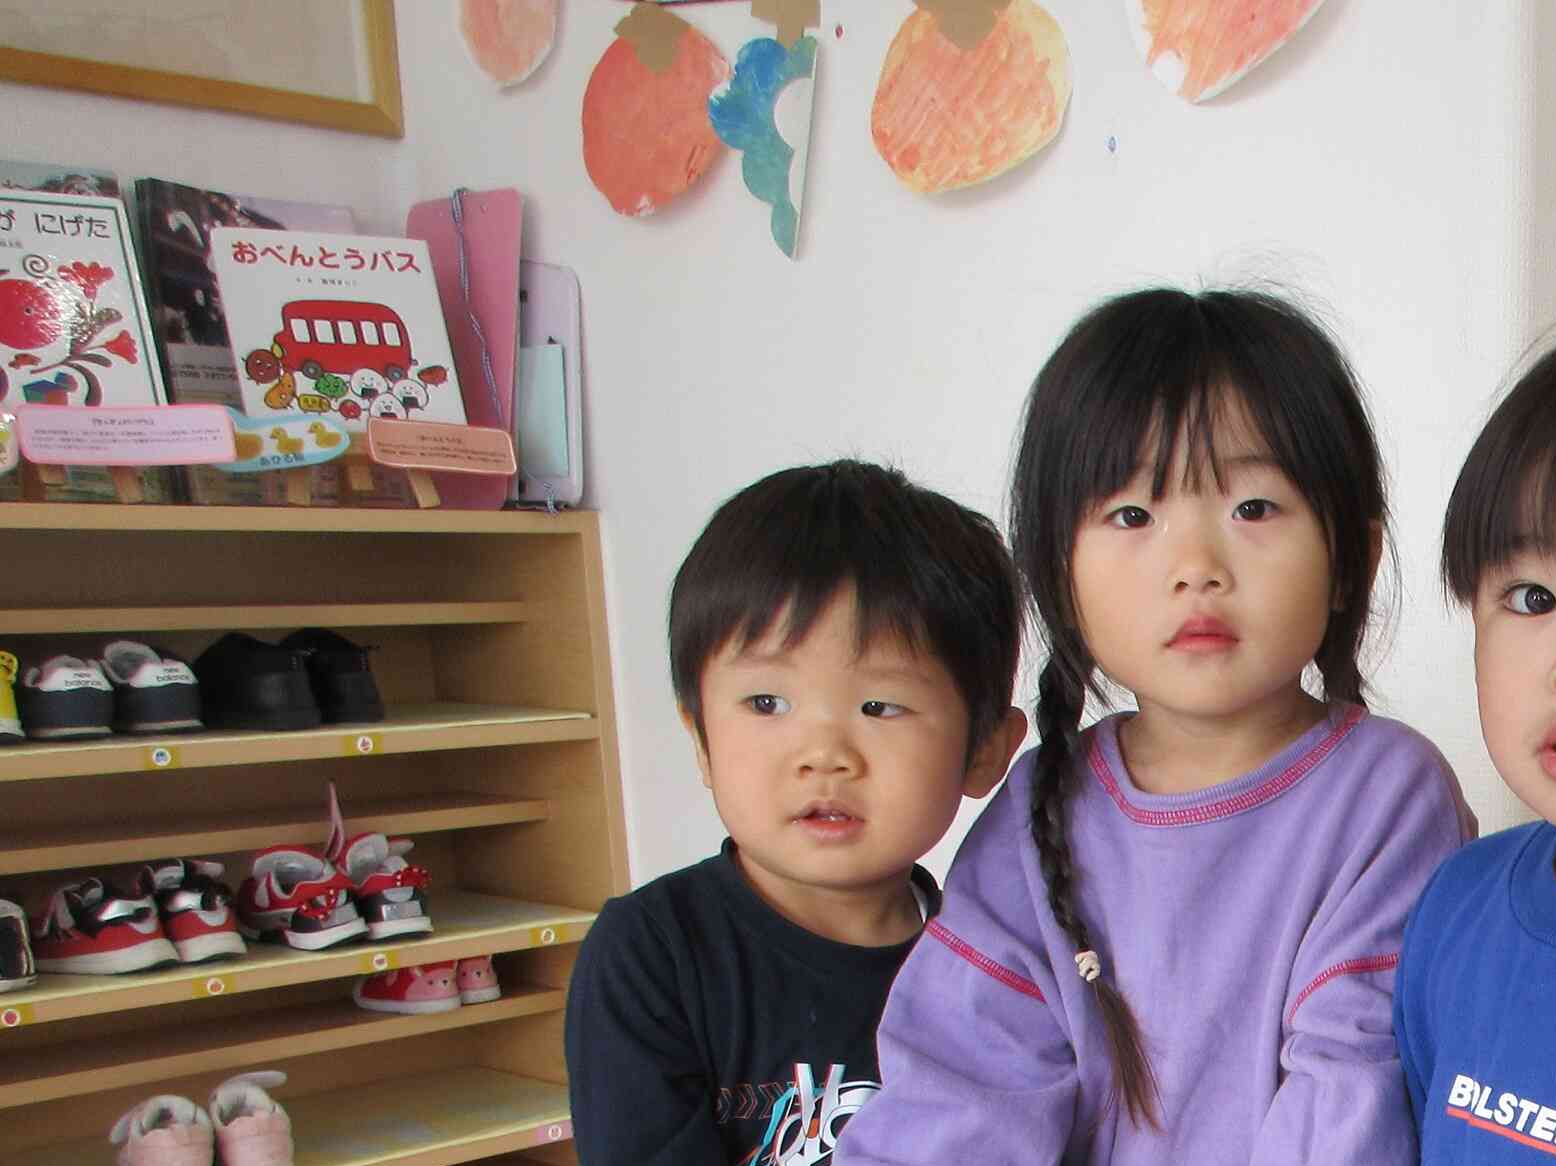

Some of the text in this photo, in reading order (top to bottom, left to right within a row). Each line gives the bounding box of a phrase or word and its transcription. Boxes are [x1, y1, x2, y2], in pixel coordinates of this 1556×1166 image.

[34, 212, 111, 239] にげた
[231, 241, 421, 273] おべんとうバス
